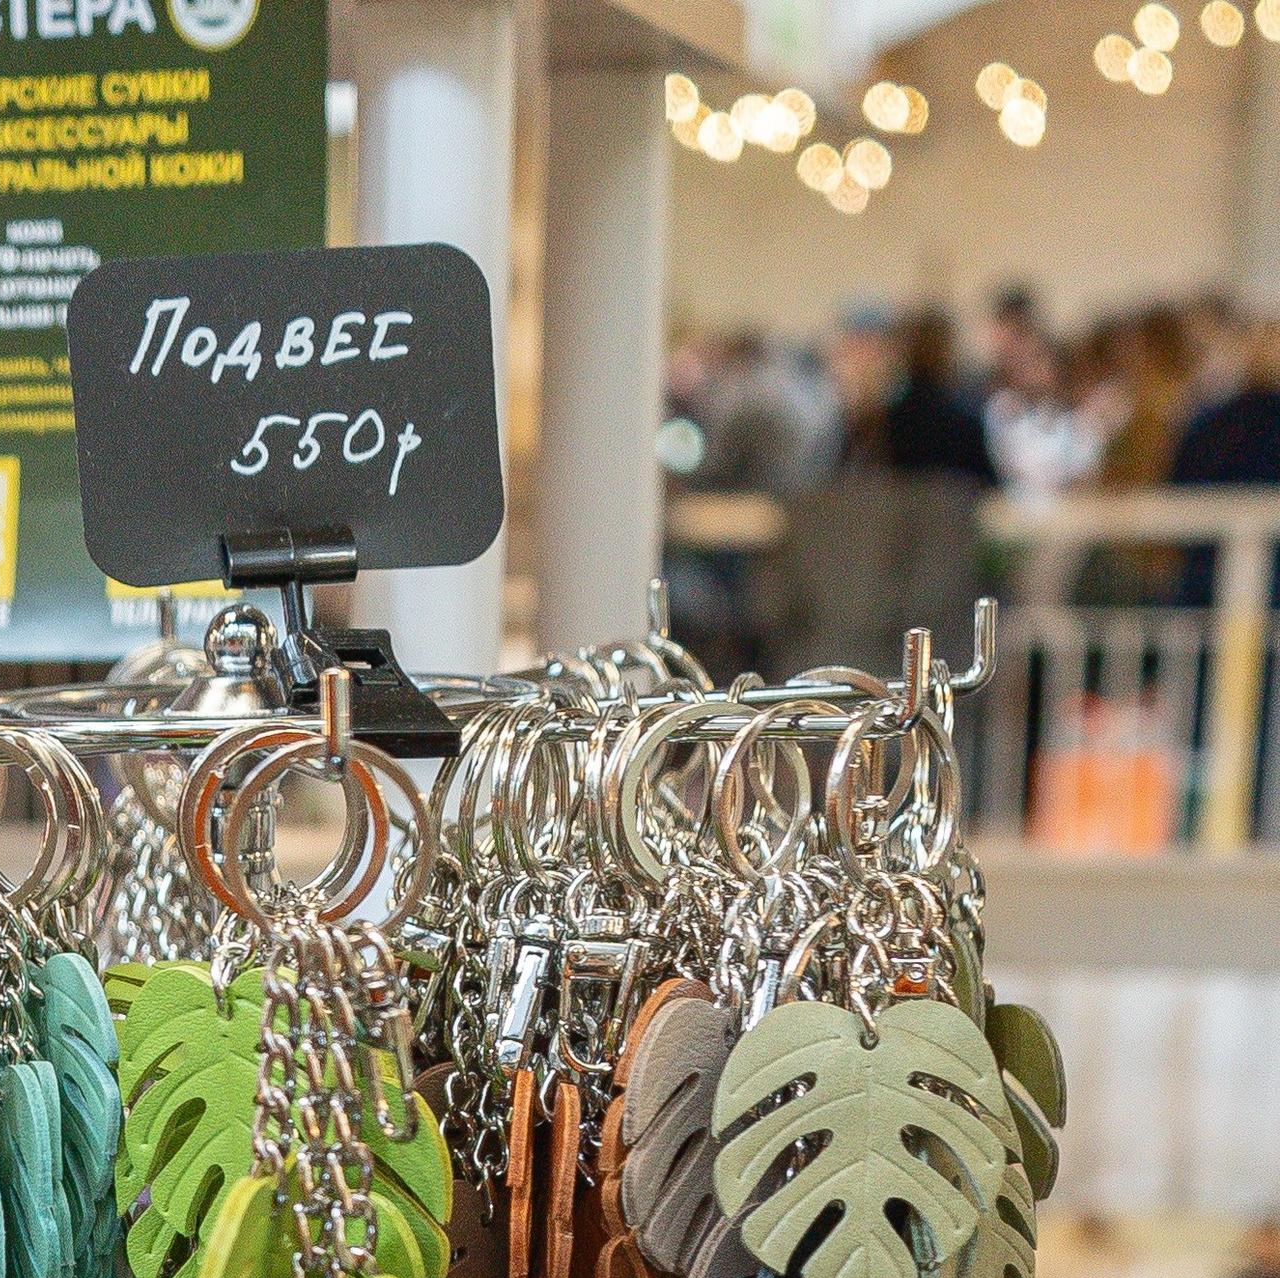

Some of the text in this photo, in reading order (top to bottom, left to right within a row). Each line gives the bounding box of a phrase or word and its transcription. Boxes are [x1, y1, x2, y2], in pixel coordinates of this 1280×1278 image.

[101, 68, 210, 104] СУМКИ
[150, 151, 244, 188] КОЖИ
[231, 408, 422, 496] 550р
